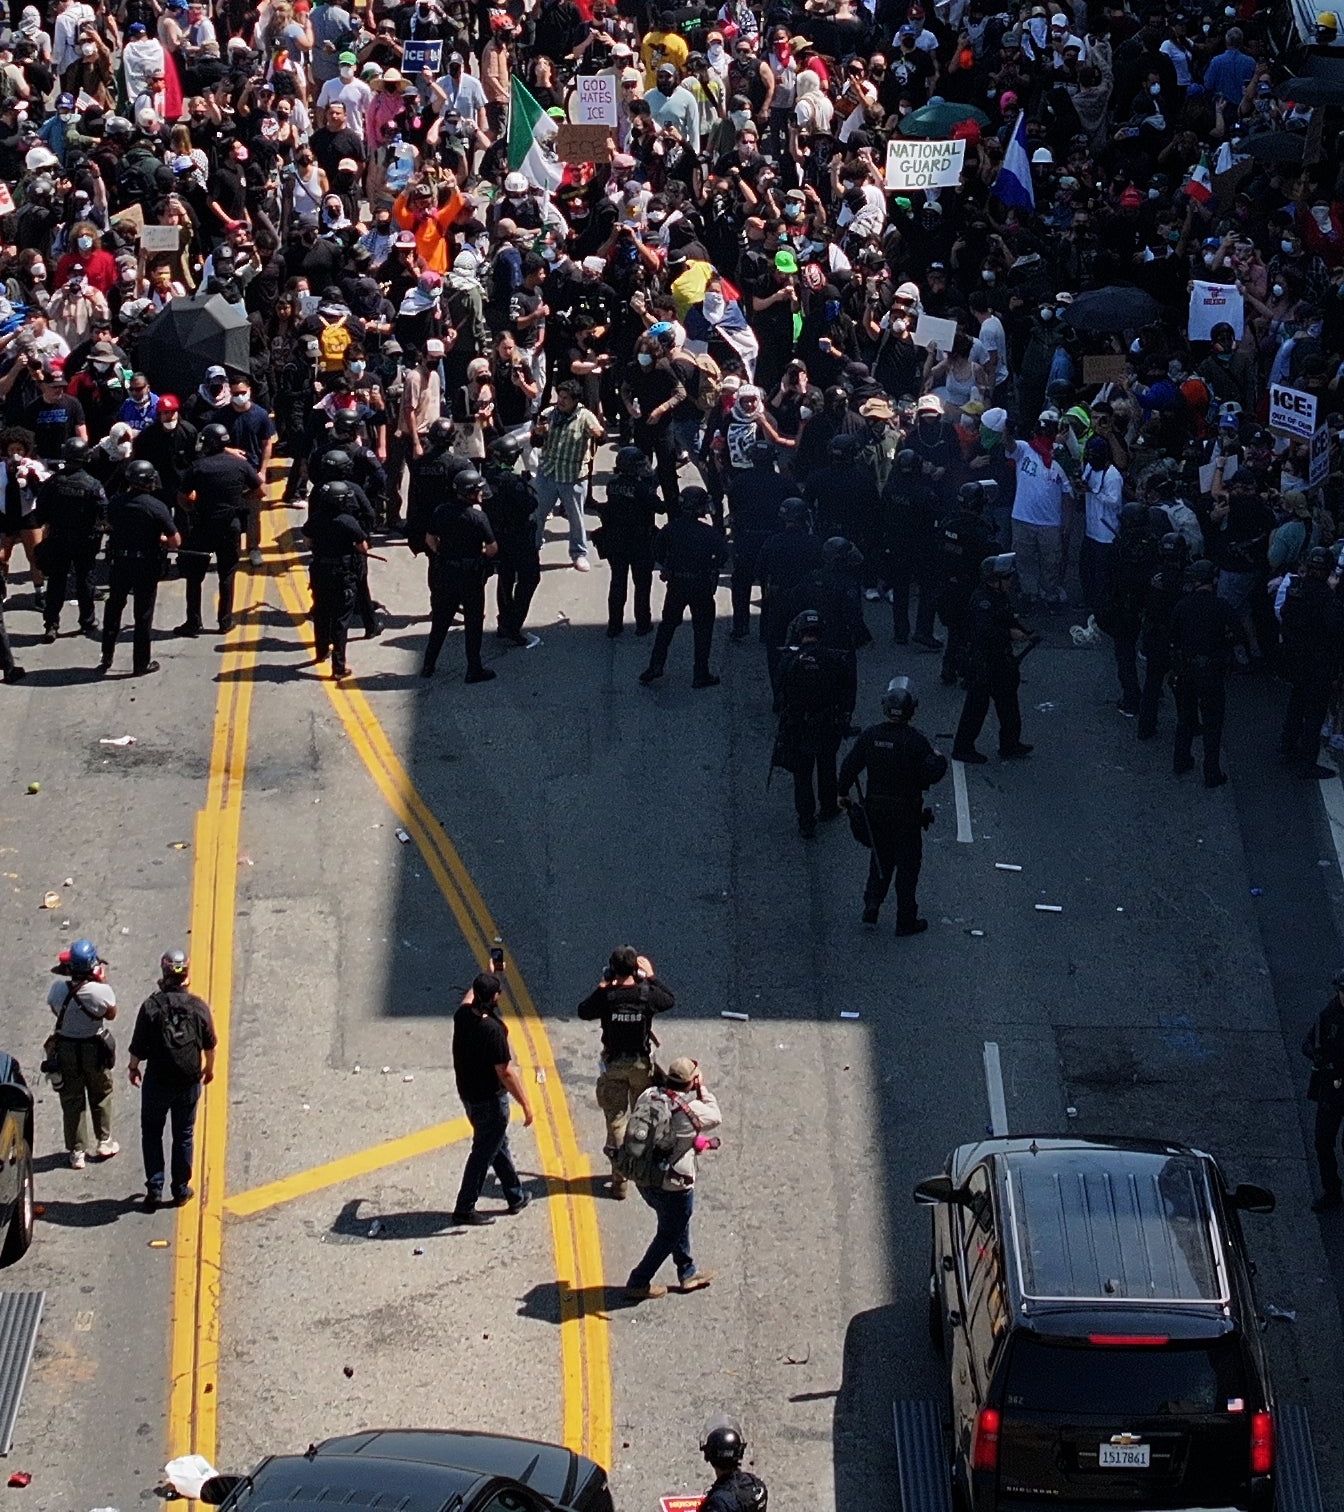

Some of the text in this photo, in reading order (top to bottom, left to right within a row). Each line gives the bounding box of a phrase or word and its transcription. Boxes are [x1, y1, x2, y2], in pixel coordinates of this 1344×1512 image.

[405, 50, 425, 61] ICE
[582, 79, 607, 92] GOD
[580, 92, 612, 104] HATES
[587, 106, 604, 120] ICE
[889, 141, 960, 158] NATIONAL
[900, 157, 952, 173] GUARD
[904, 173, 938, 187] LOL
[1272, 389, 1312, 418] ICE:
[611, 1013, 642, 1022] PRESS
[1103, 1451, 1145, 1464] 1517861
